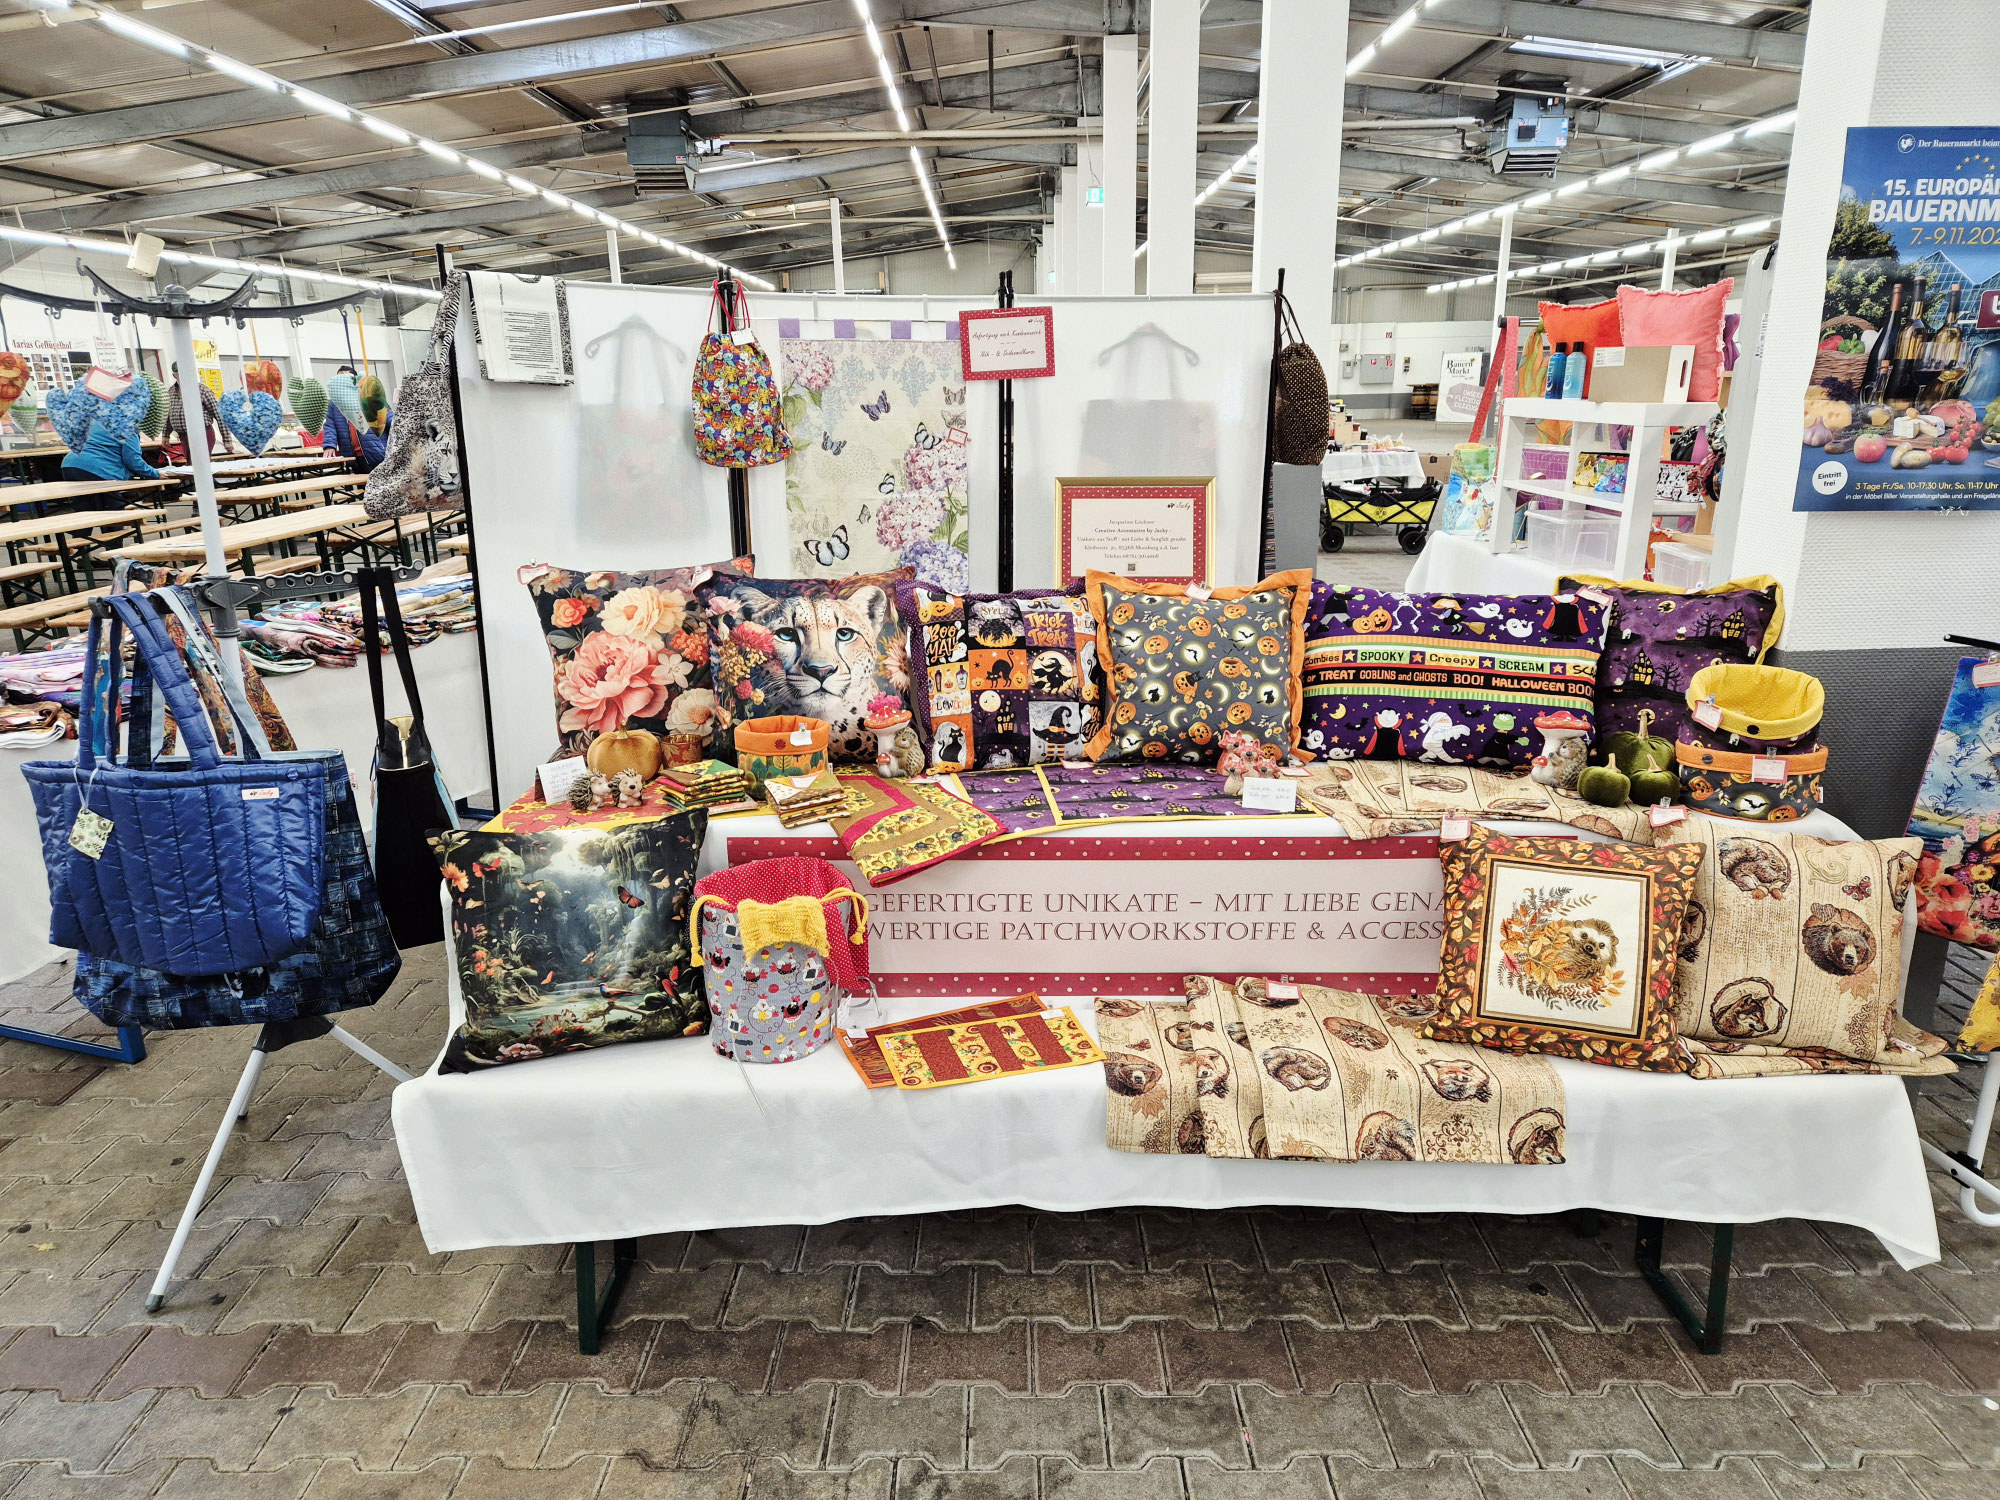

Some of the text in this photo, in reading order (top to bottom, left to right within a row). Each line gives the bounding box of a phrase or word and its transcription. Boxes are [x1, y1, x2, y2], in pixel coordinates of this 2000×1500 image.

[1933, 139, 1981, 148] Bauernmarkt
[1883, 178, 1911, 196] 15.
[1868, 198, 2000, 223] BAUERNM
[1447, 359, 1473, 369] Bauern
[1449, 367, 1470, 375] Markt
[1817, 471, 1842, 480] Eintritt
[1823, 479, 1836, 487] frei
[1855, 482, 1861, 490] 3
[1863, 482, 1881, 492] Tage
[1954, 481, 1966, 490] So.
[1984, 481, 1999, 490] Uhr
[1360, 651, 1405, 661] SPOOKY
[1429, 653, 1476, 666] Creepy
[1498, 659, 1545, 673] SCREAM
[1306, 673, 1317, 683] or
[1319, 669, 1356, 681] TREAT
[1360, 669, 1397, 681] GOBLINS
[1397, 671, 1412, 681] and
[1413, 672, 1448, 683] GHOSTS
[1453, 672, 1485, 686] BOO!
[1491, 676, 1566, 692] HALLOWEEN
[1043, 893, 1179, 913] UNIKATE
[1214, 892, 1273, 913] MIT
[1284, 892, 1361, 912] LIEBE
[999, 921, 1297, 941] PATCHWORKSTOFFE
[1306, 920, 1326, 940] &
